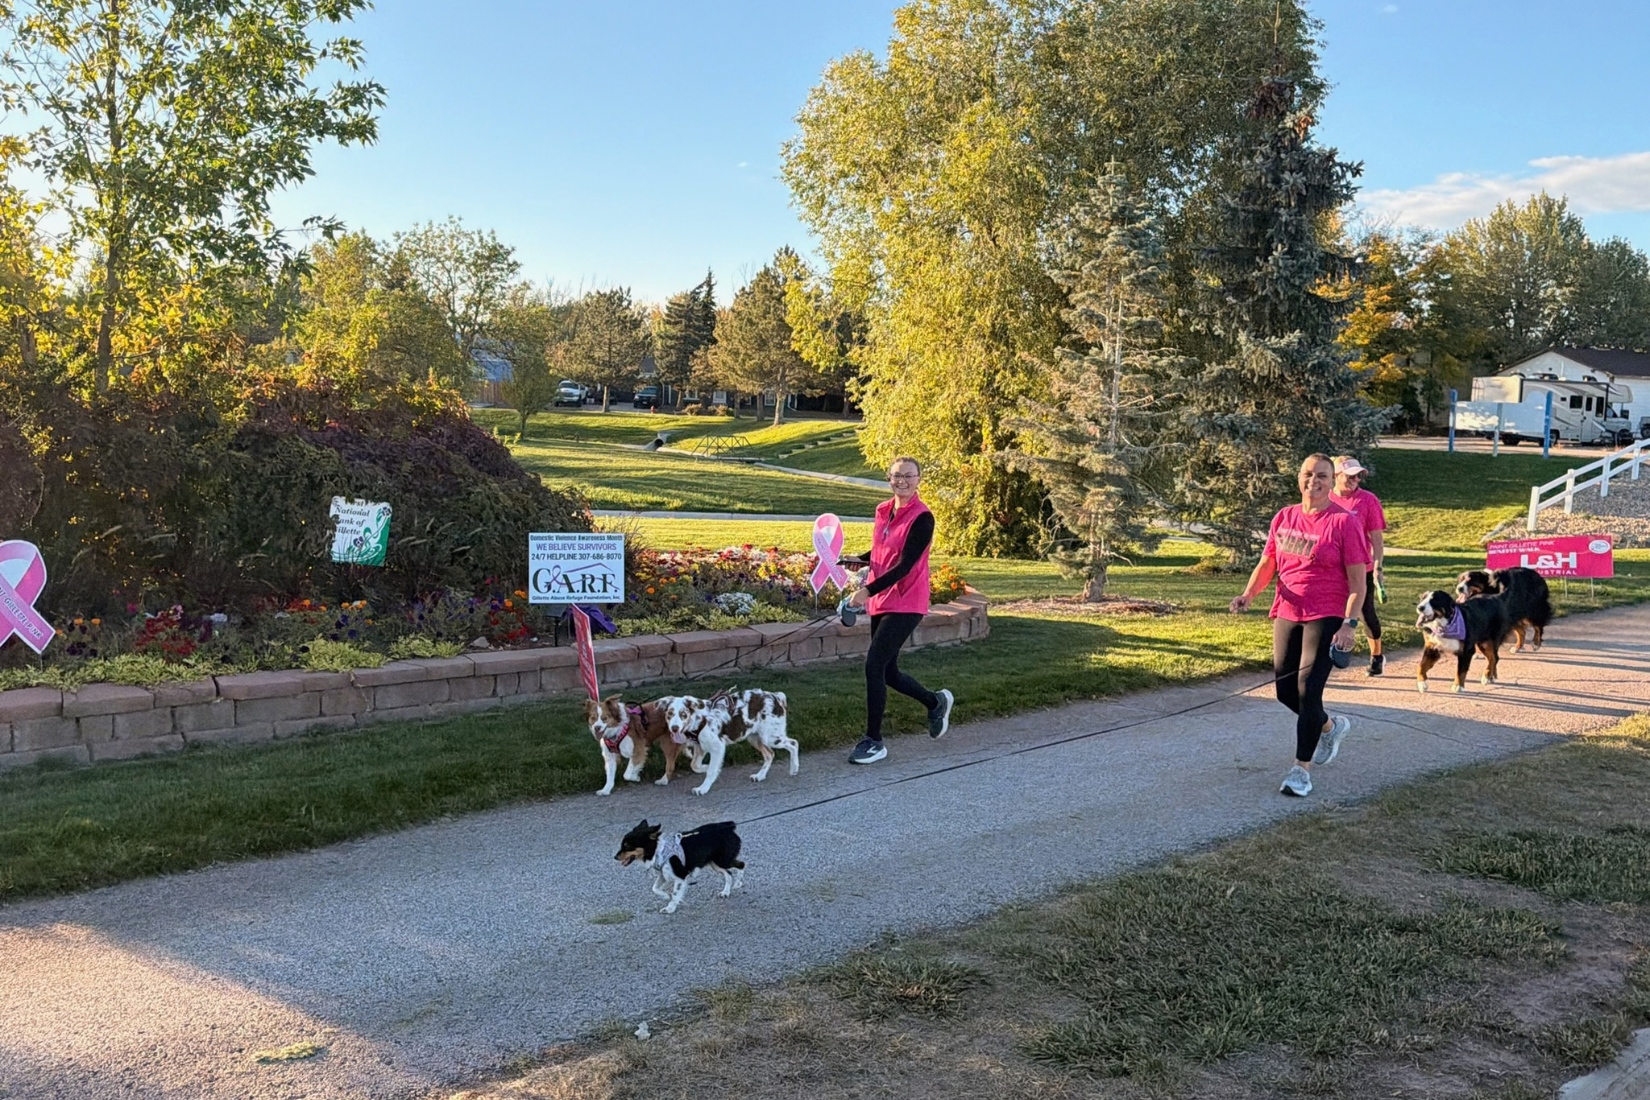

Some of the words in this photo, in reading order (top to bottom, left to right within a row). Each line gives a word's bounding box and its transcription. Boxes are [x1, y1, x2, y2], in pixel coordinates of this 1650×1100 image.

[335, 507, 370, 516] National
[356, 519, 366, 527] of
[338, 526, 361, 535] illette
[536, 543, 547, 551] WE
[548, 543, 576, 551] BELIEVE
[577, 543, 617, 551] SURVIVORS
[1520, 552, 1577, 569] L&H
[4, 598, 28, 624] GILLETTE
[26, 623, 42, 638] PINK
